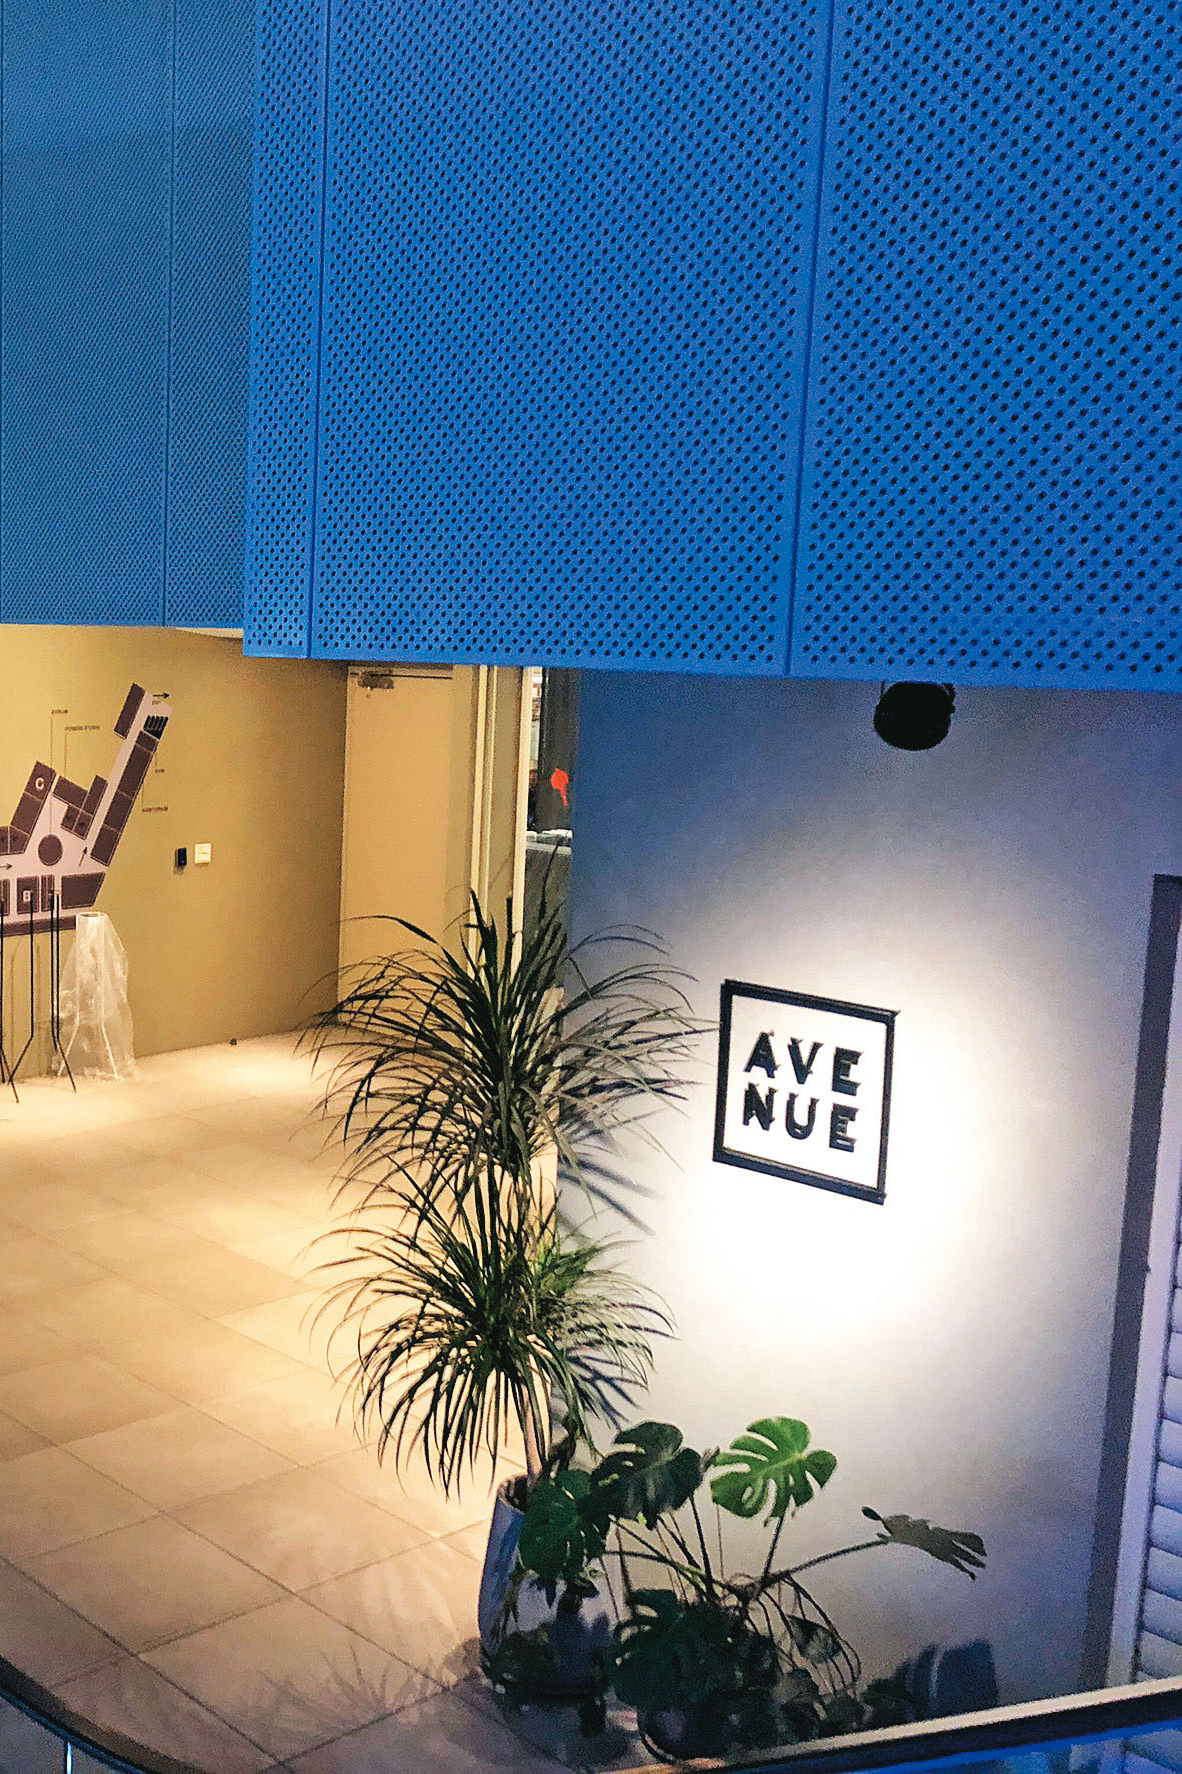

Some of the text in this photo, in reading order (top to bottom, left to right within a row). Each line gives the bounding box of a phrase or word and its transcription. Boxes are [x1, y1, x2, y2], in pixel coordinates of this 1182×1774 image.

[35, 777, 45, 790] C
[744, 1030, 864, 1096] AVE
[742, 1081, 860, 1152] NUE
